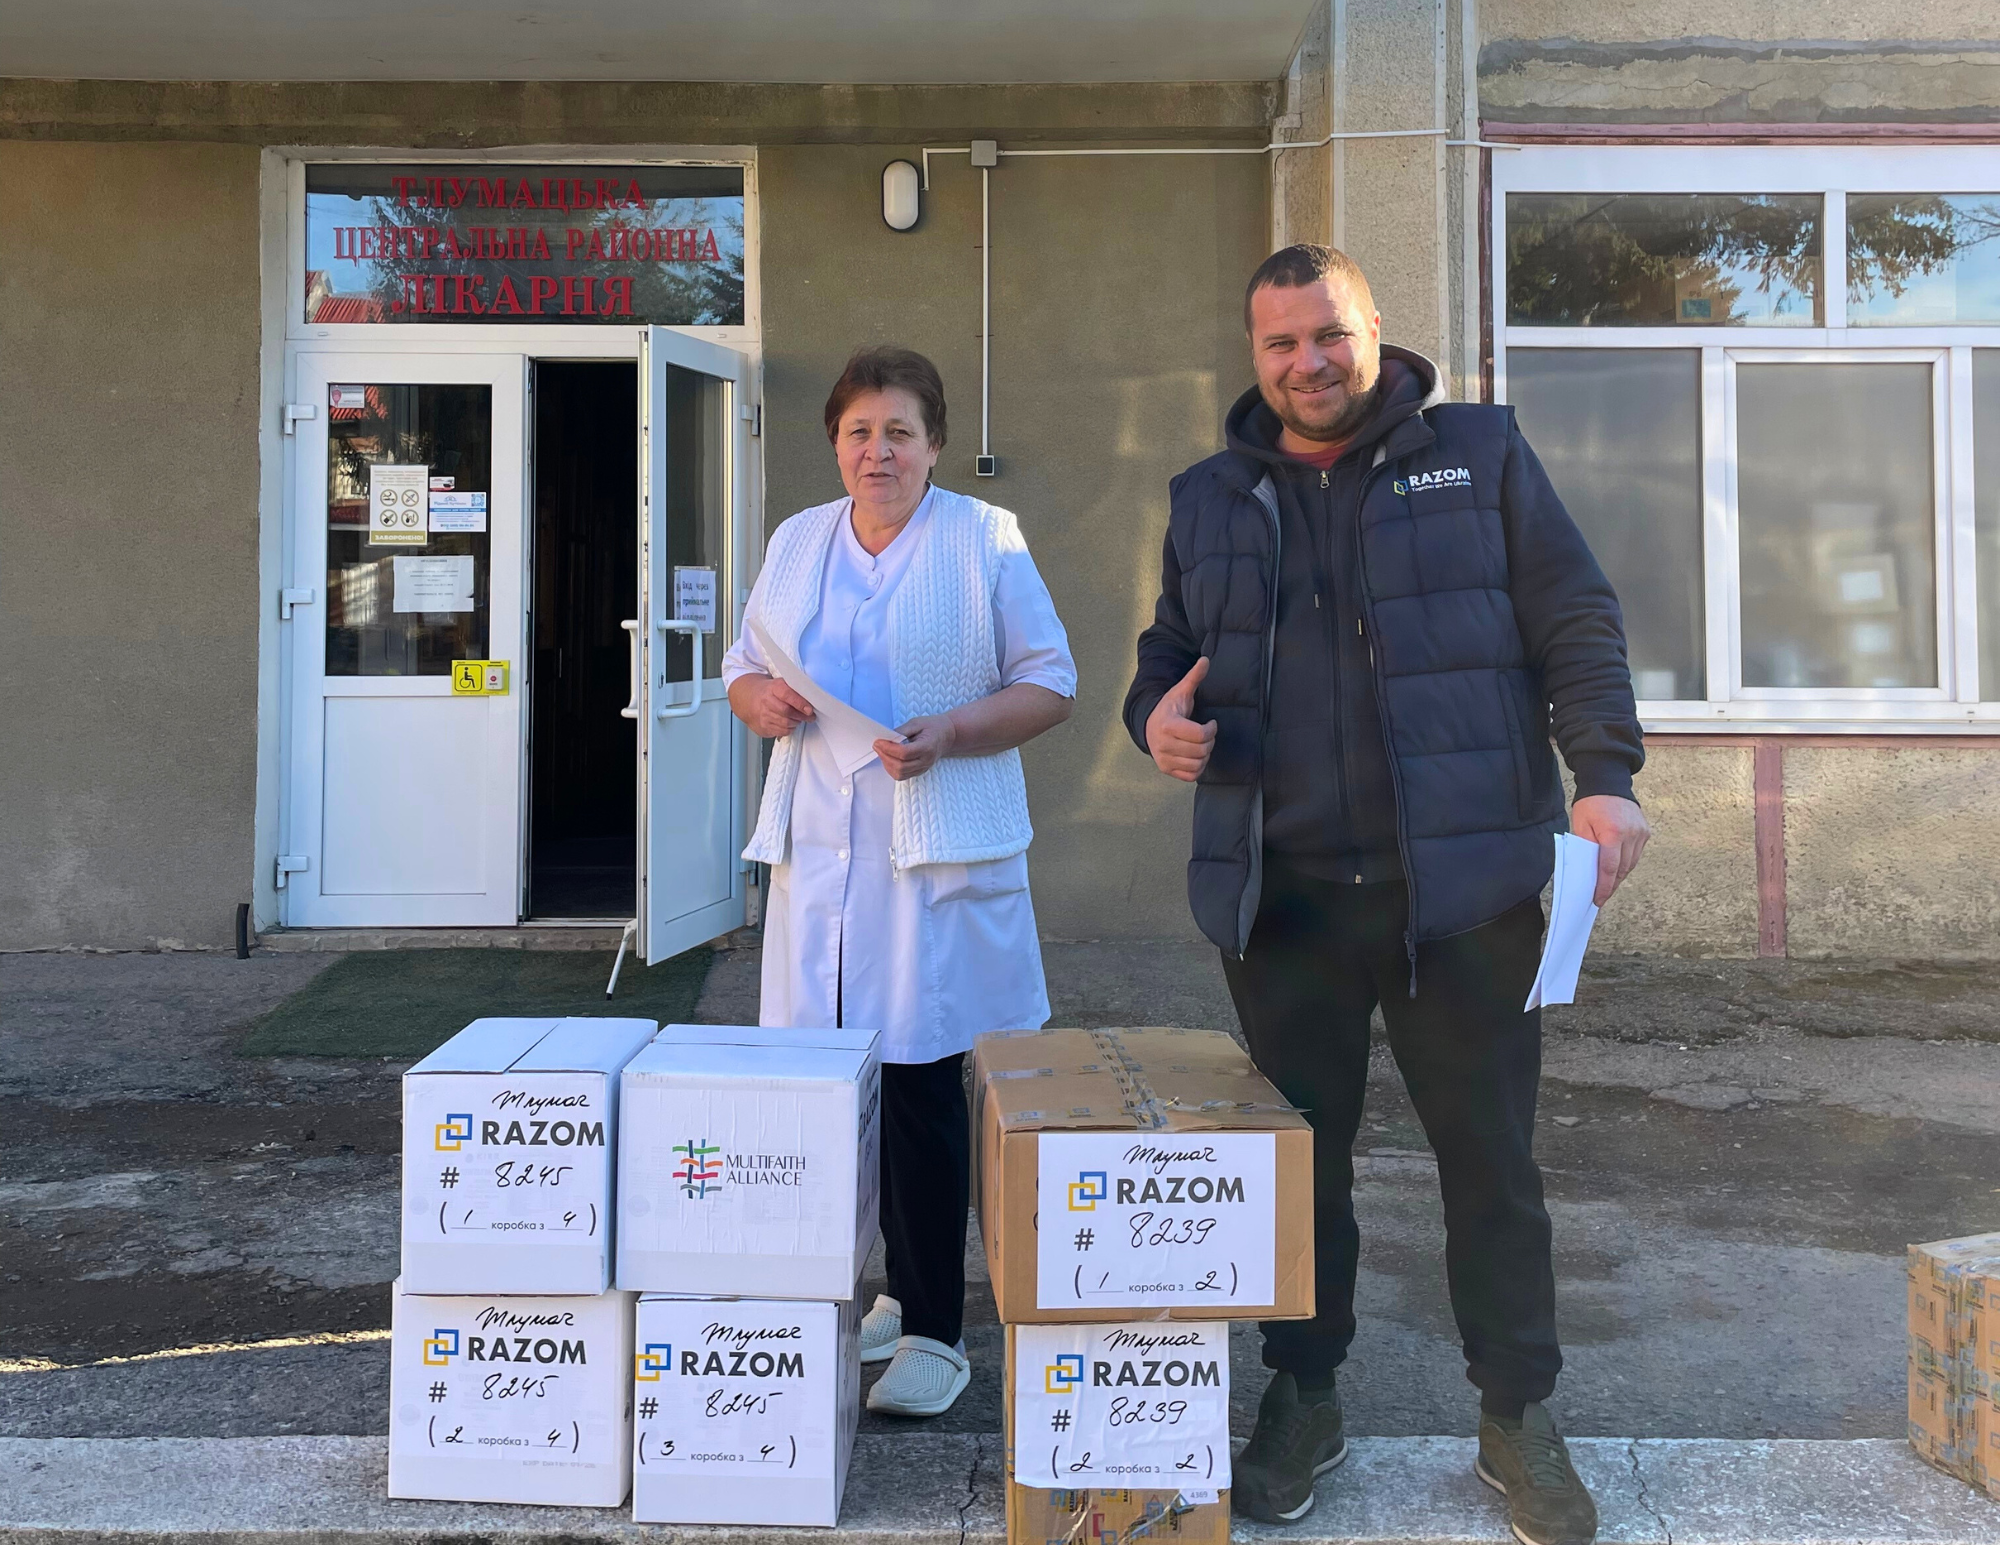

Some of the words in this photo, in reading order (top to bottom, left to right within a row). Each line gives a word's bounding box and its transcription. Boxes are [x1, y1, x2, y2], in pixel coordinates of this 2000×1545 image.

[392, 177, 645, 213] ТЛУМАЦЬКА
[333, 227, 551, 266] ЦЕНТРАЛЬНА
[566, 221, 721, 261] РАЙОННА
[392, 275, 633, 315] ЛІКАРНЯ
[1408, 467, 1471, 487] RAZOM
[482, 1121, 604, 1146] RAZOM
[495, 1162, 573, 1187] 8245
[727, 1155, 805, 1169] MULTIFAITH
[727, 1171, 802, 1185] ALLIANCE
[1118, 1177, 1244, 1204] RAZOM
[491, 1221, 536, 1231] коробка
[1130, 1212, 1216, 1248] 8239
[1129, 1283, 1175, 1293] коробка
[469, 1337, 586, 1364] RAZOM
[682, 1351, 804, 1377] RAZOM
[1094, 1361, 1220, 1386] RAZOM
[483, 1373, 558, 1400] 8245
[706, 1389, 782, 1417] 8245
[1110, 1397, 1187, 1426] 8239
[478, 1437, 521, 1446] коробка
[690, 1453, 735, 1462] коробка
[1105, 1465, 1151, 1474] коробка
